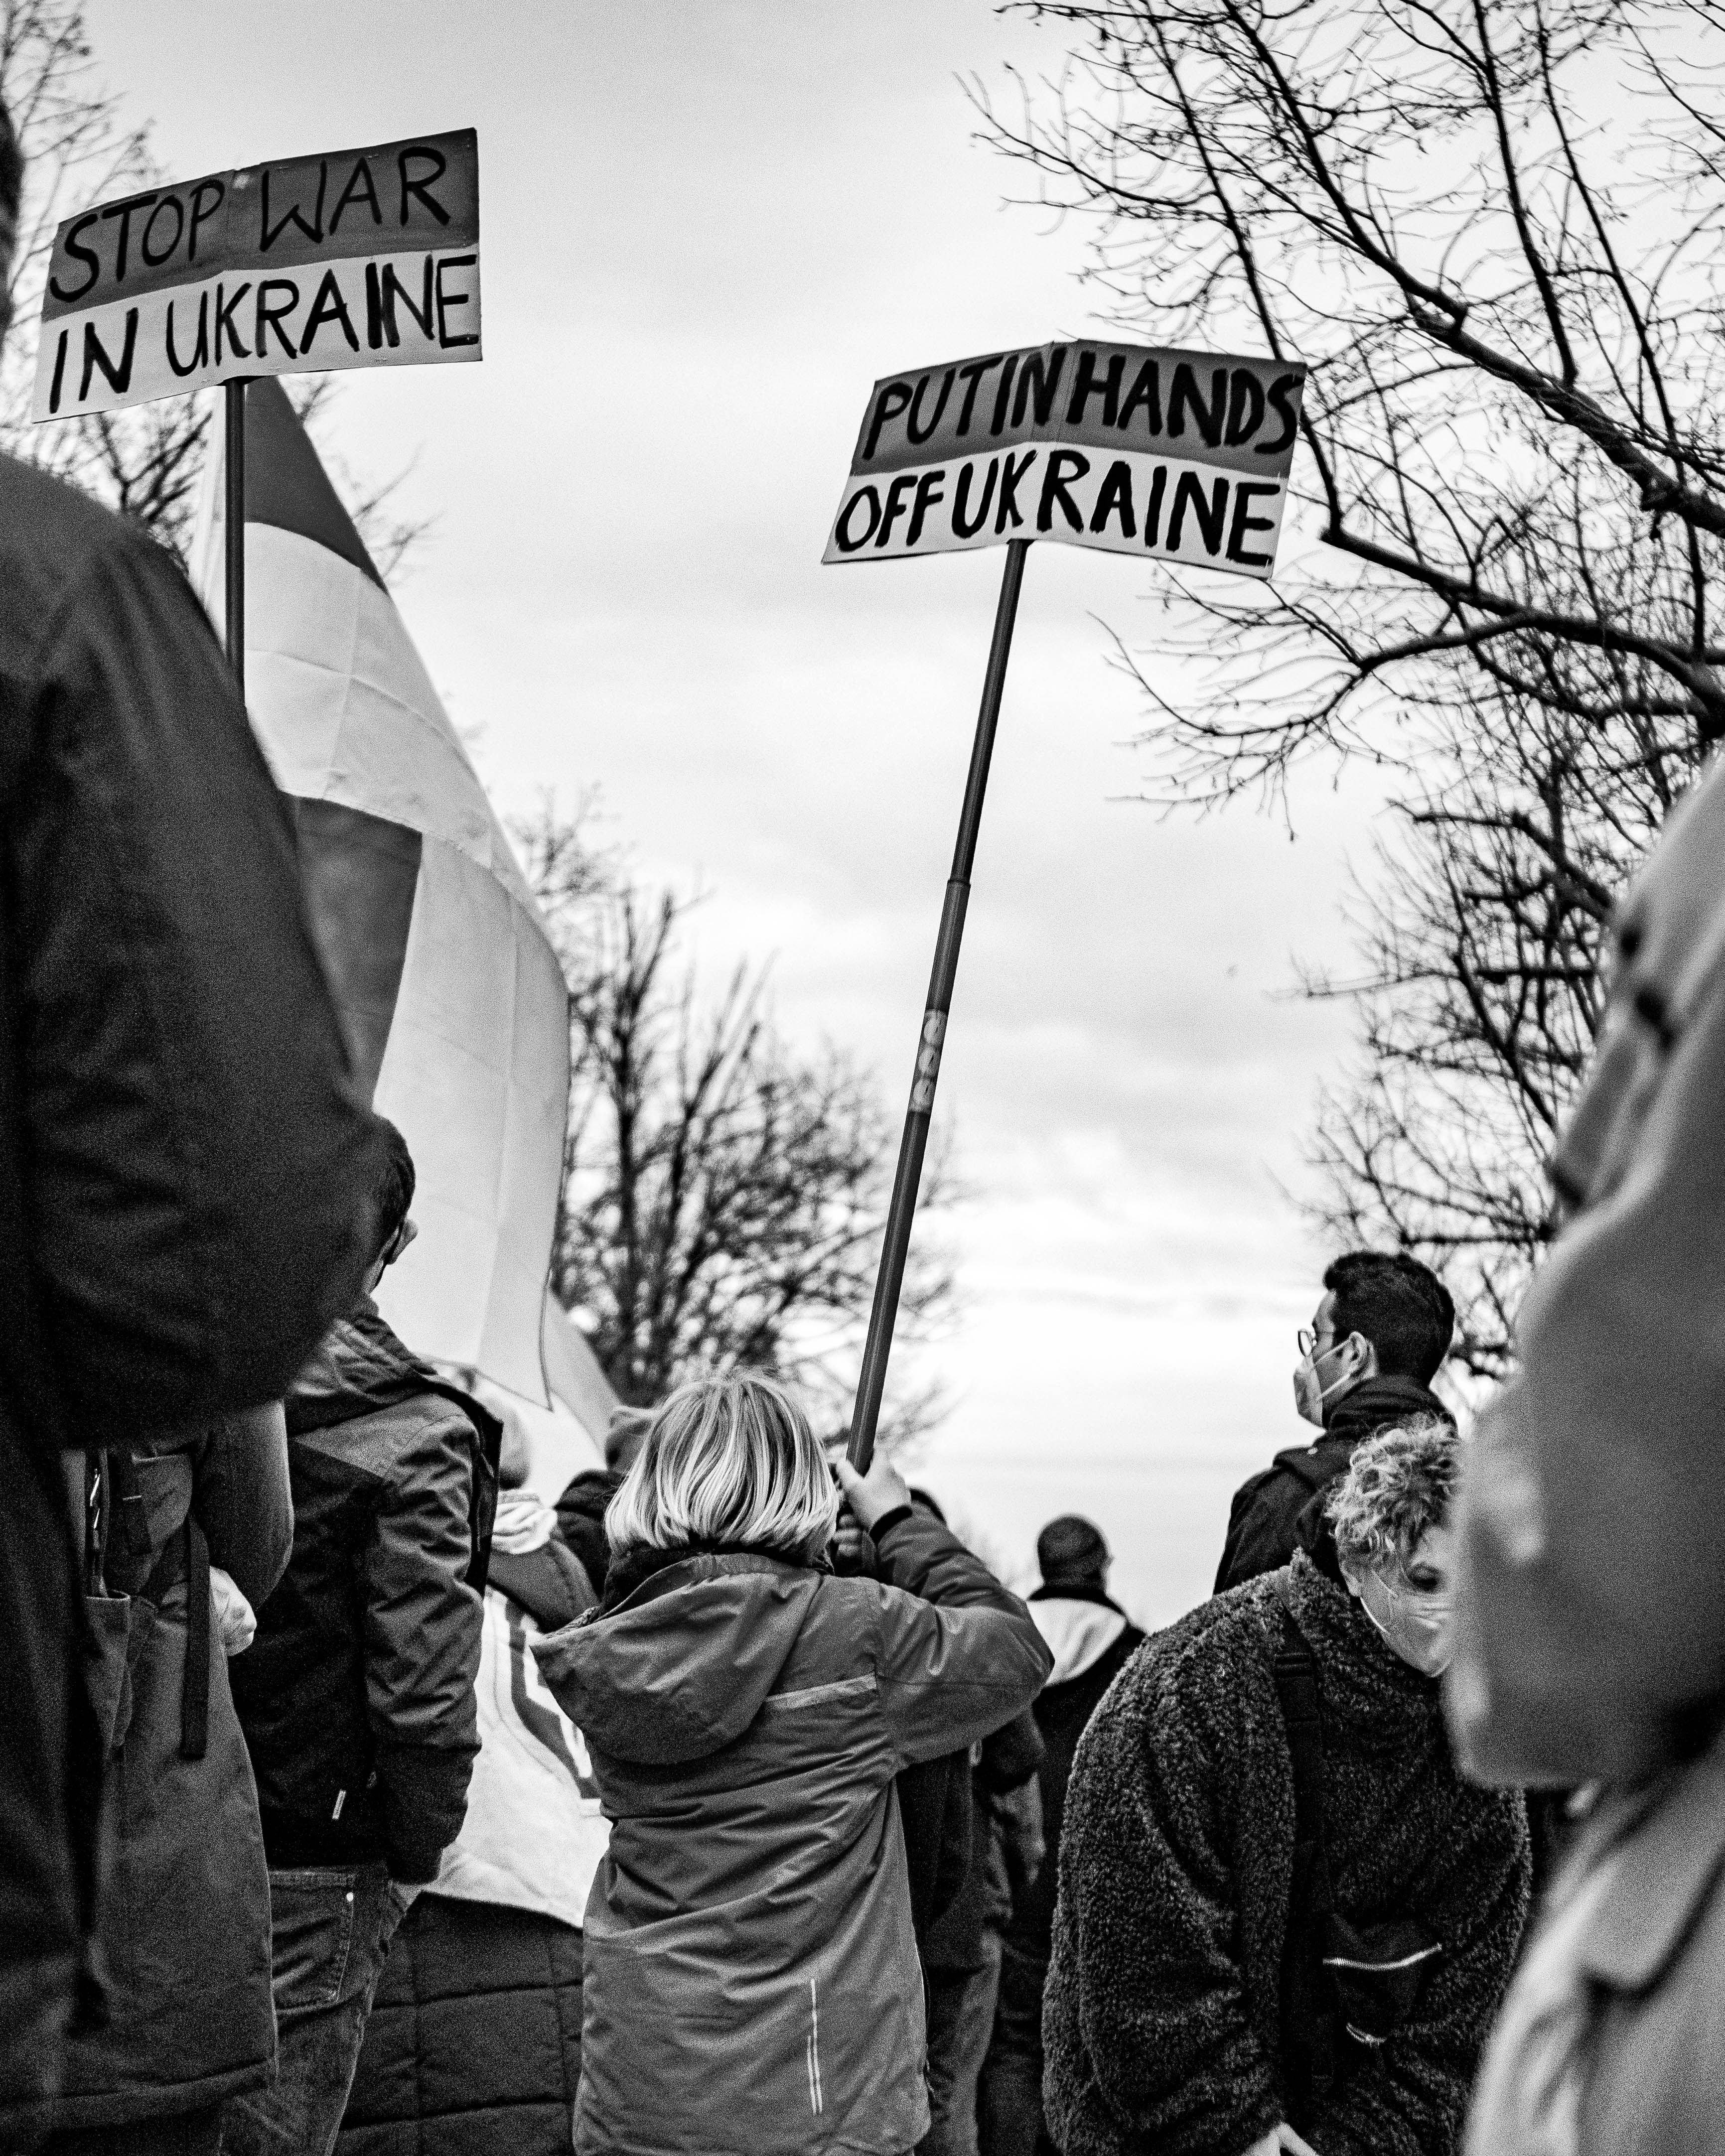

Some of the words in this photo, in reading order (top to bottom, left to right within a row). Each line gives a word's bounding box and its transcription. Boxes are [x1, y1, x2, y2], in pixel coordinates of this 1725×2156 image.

[49, 179, 225, 301] STOP
[260, 146, 451, 252] WAR
[49, 307, 139, 414] IN
[165, 254, 479, 377] UKRAINE
[862, 346, 1066, 460] PUTIN
[1065, 351, 1304, 454] HANDS
[834, 469, 946, 552] OFF
[951, 449, 1281, 565] UKRAINE
